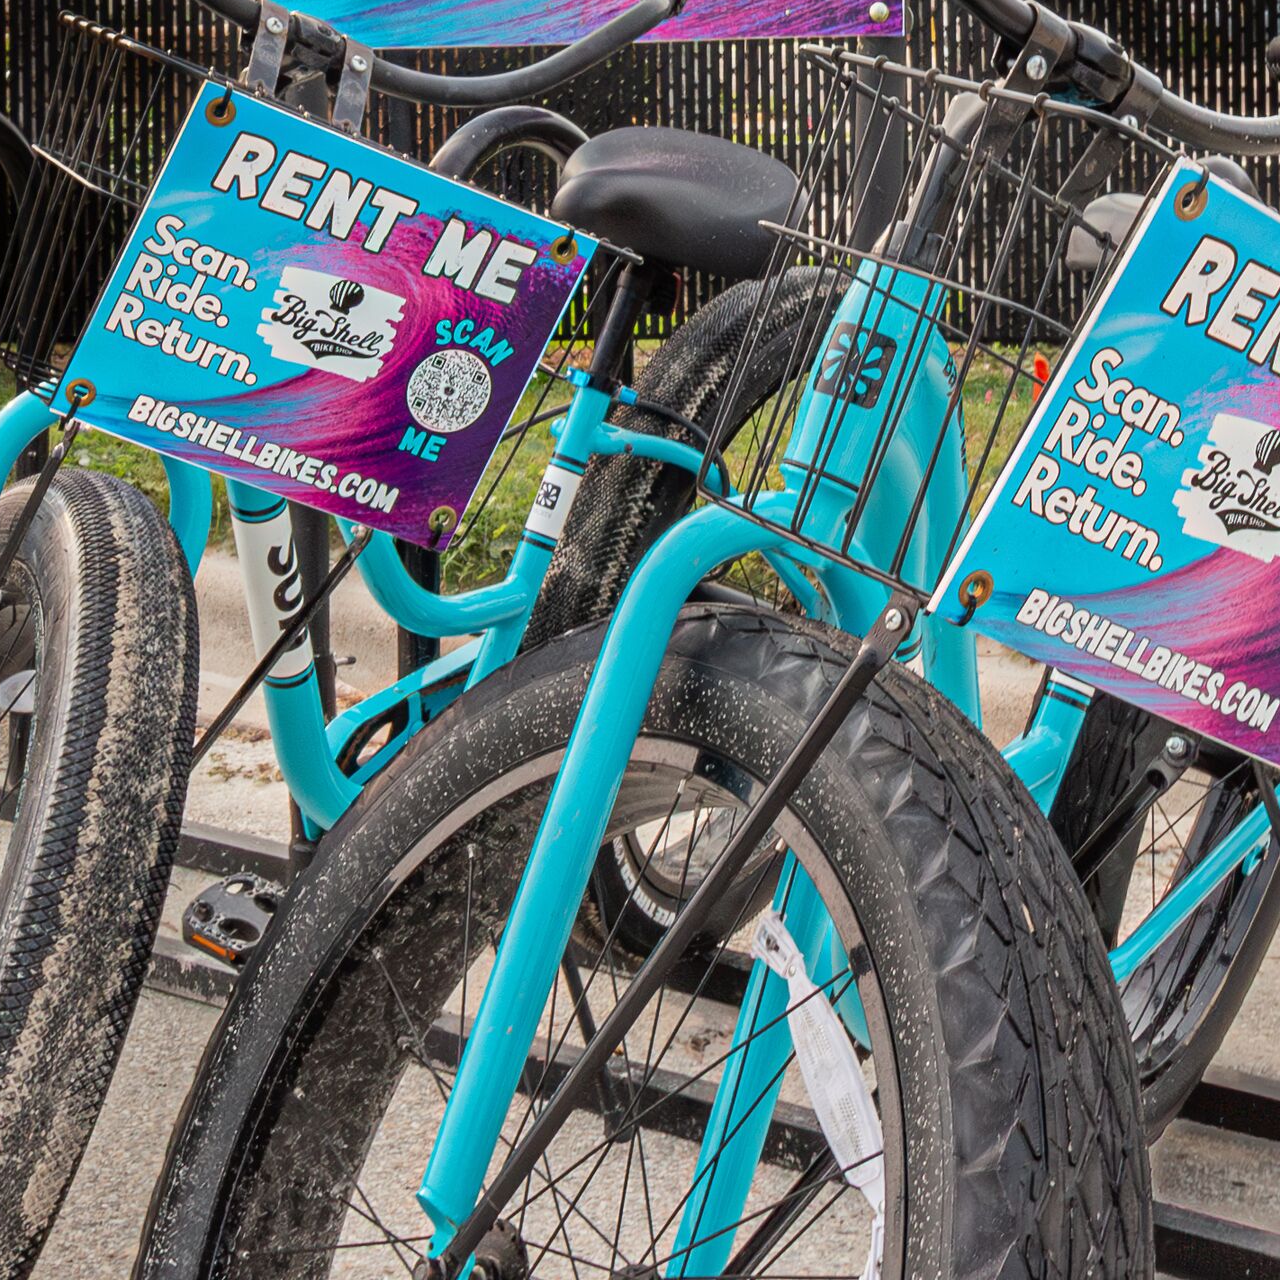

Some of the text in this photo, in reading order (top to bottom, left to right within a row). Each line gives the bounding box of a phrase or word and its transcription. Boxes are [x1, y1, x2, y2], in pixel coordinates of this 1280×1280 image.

[143, 214, 258, 293] Scan.
[212, 130, 538, 307] RENT ME
[124, 250, 230, 329] Ride.
[271, 294, 384, 354] Big Shell
[104, 293, 259, 387] Return.
[310, 342, 334, 353] BIKE
[435, 319, 515, 367] SCAN
[1073, 346, 1185, 448] Scan.
[127, 394, 400, 515] BIGSHELLBIKES.COM
[398, 425, 447, 462] ME
[1043, 398, 1148, 497] Ride.
[1191, 450, 1238, 510] Big
[1012, 454, 1164, 572] Return.
[1224, 512, 1249, 526] BIKE
